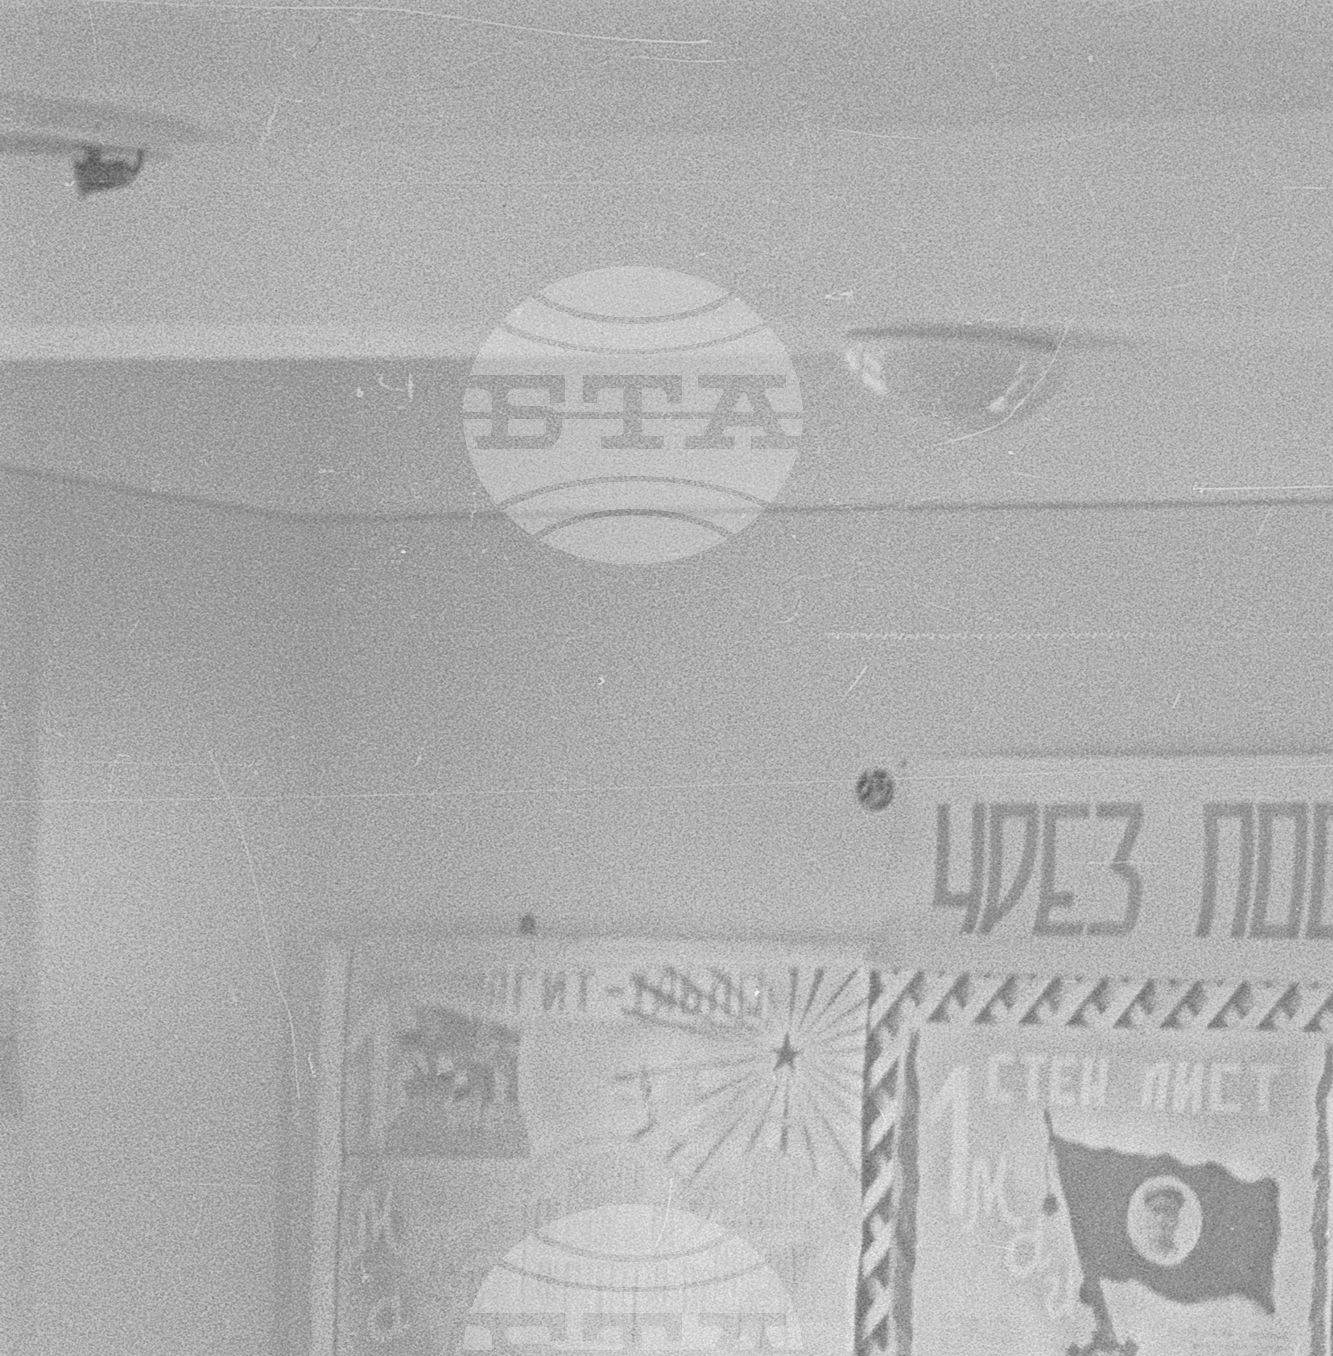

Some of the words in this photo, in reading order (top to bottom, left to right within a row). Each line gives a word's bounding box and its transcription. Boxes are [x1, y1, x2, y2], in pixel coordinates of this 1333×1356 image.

[932, 801, 1146, 936] ЧРЕЗ
[985, 1051, 1111, 1107] СТЕН
[1139, 1057, 1281, 1115] ЛИСТ
